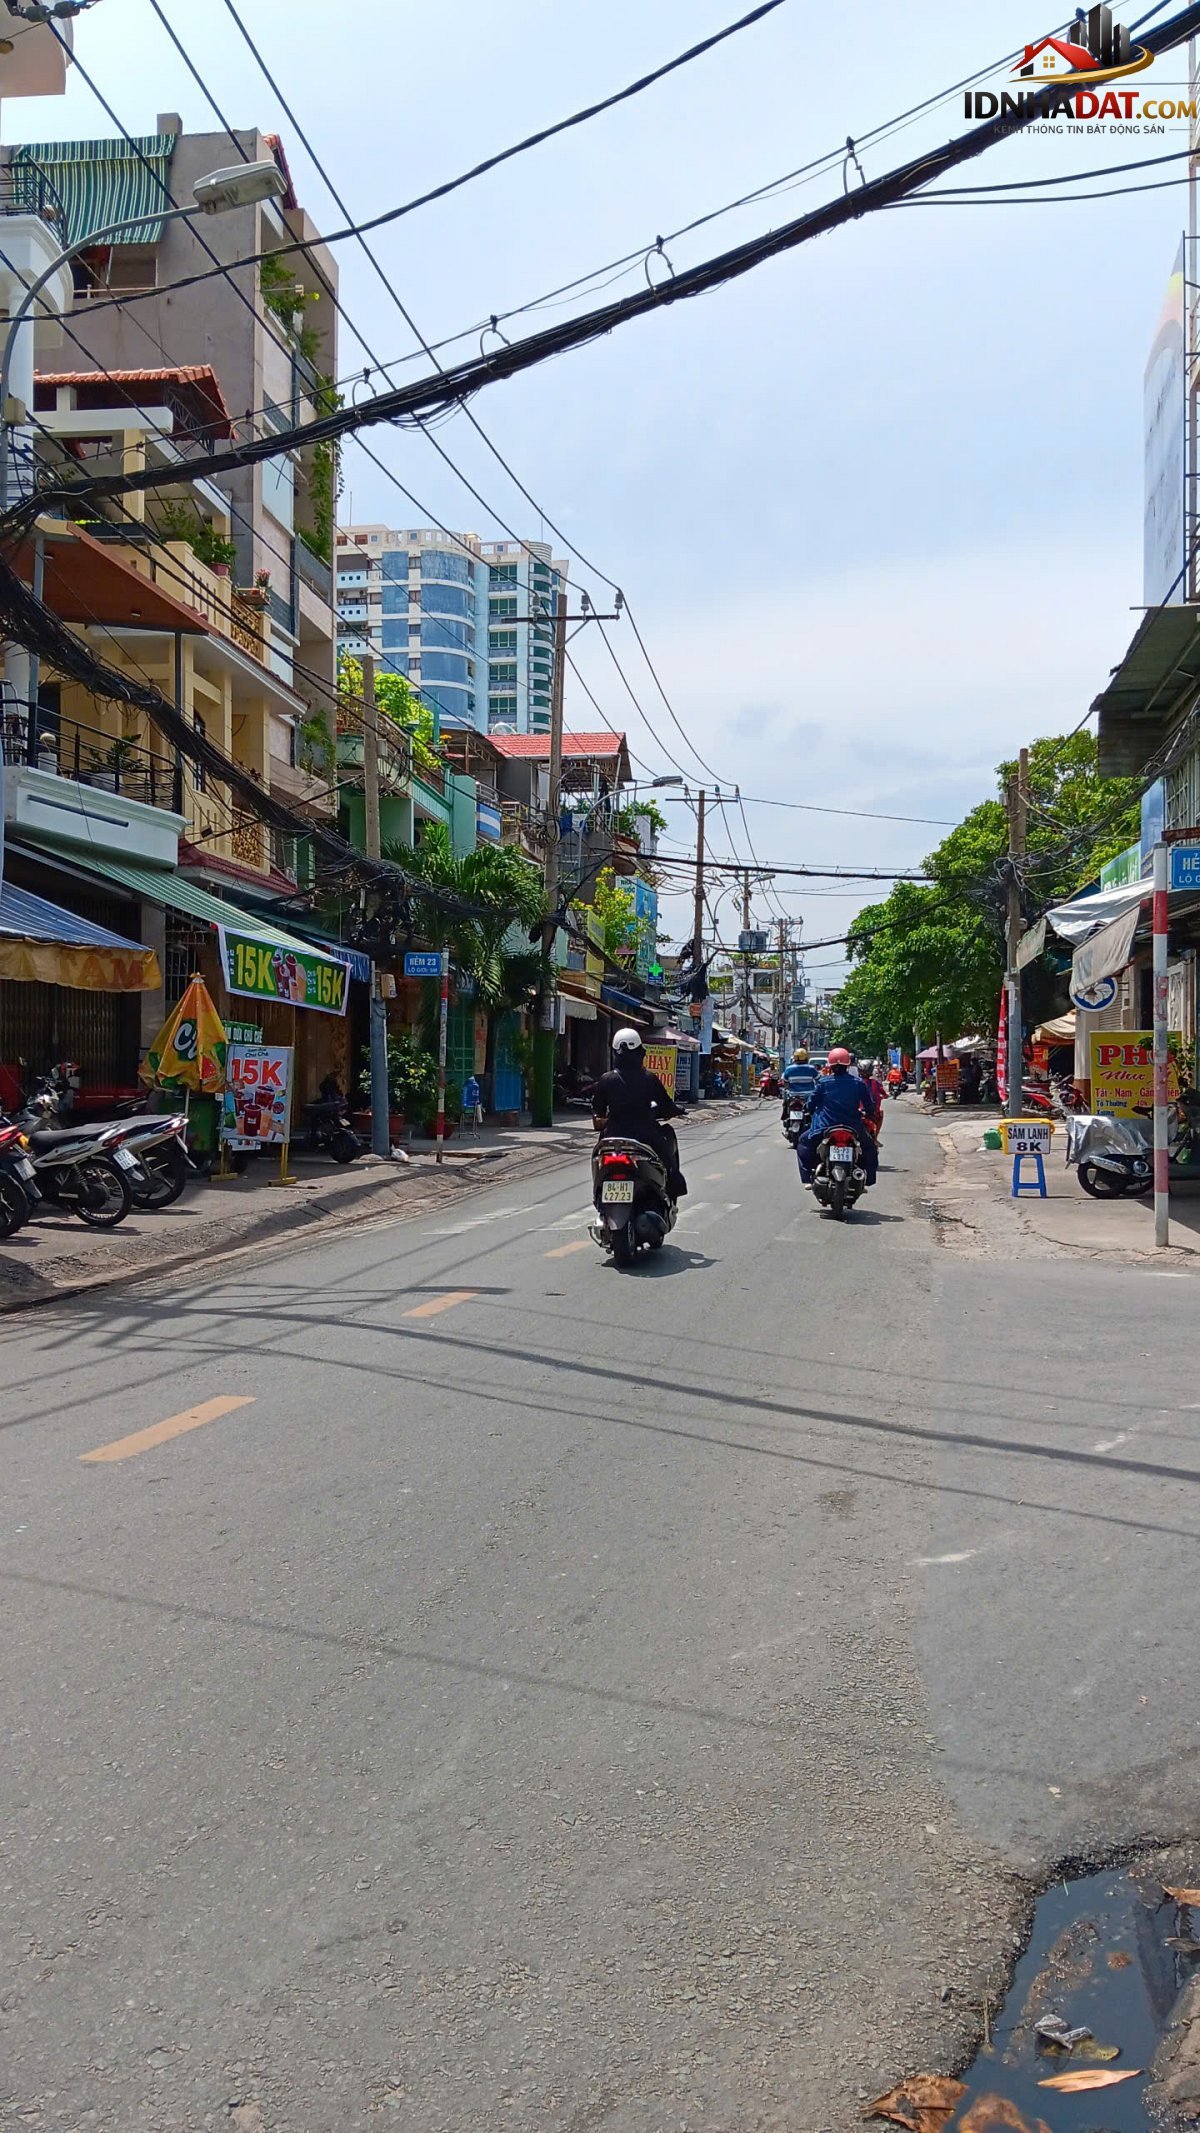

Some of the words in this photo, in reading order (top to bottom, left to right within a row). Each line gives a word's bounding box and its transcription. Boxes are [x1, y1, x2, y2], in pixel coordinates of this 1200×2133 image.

[235, 943, 275, 991] 15K
[427, 958, 437, 966] 23
[316, 964, 345, 1007] 15K
[1097, 1043, 1177, 1067] PH
[231, 1059, 283, 1087] 15K
[1016, 1141, 1042, 1152] 8K
